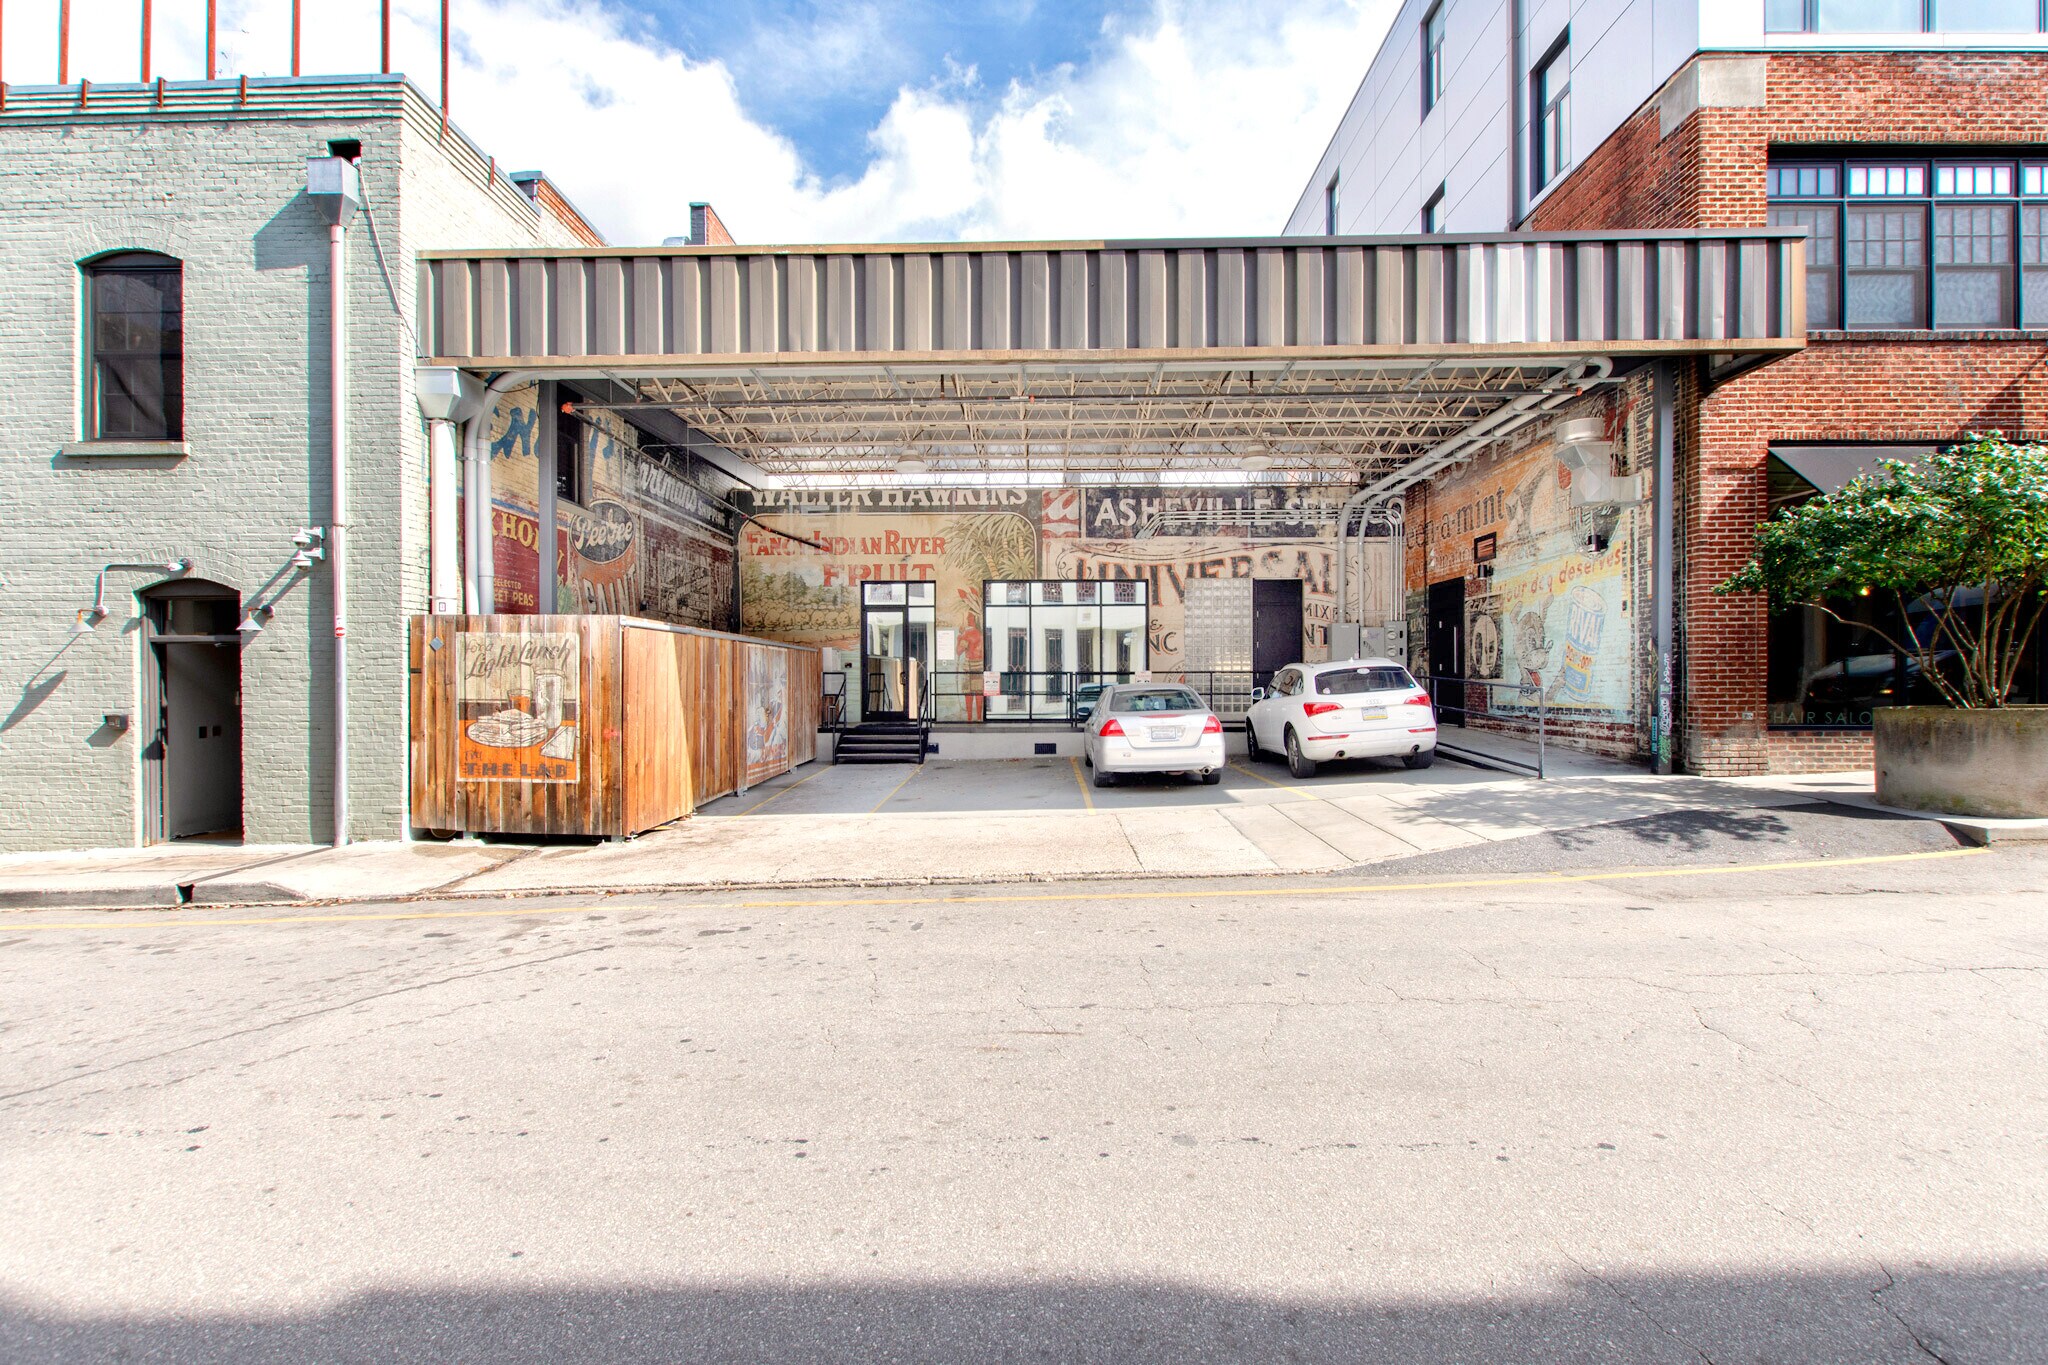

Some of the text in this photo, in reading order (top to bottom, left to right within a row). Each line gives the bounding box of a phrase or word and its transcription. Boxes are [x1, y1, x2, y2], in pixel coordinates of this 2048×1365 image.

[879, 490, 1028, 506] HAWKINS
[885, 529, 946, 555] RIVER
[823, 563, 935, 587] FRUIT
[583, 563, 637, 616] PAINT
[513, 593, 534, 607] PEAS
[466, 638, 571, 679] Light Lunch
[1773, 711, 1816, 724] HAIR
[464, 762, 568, 778] THE LAB
